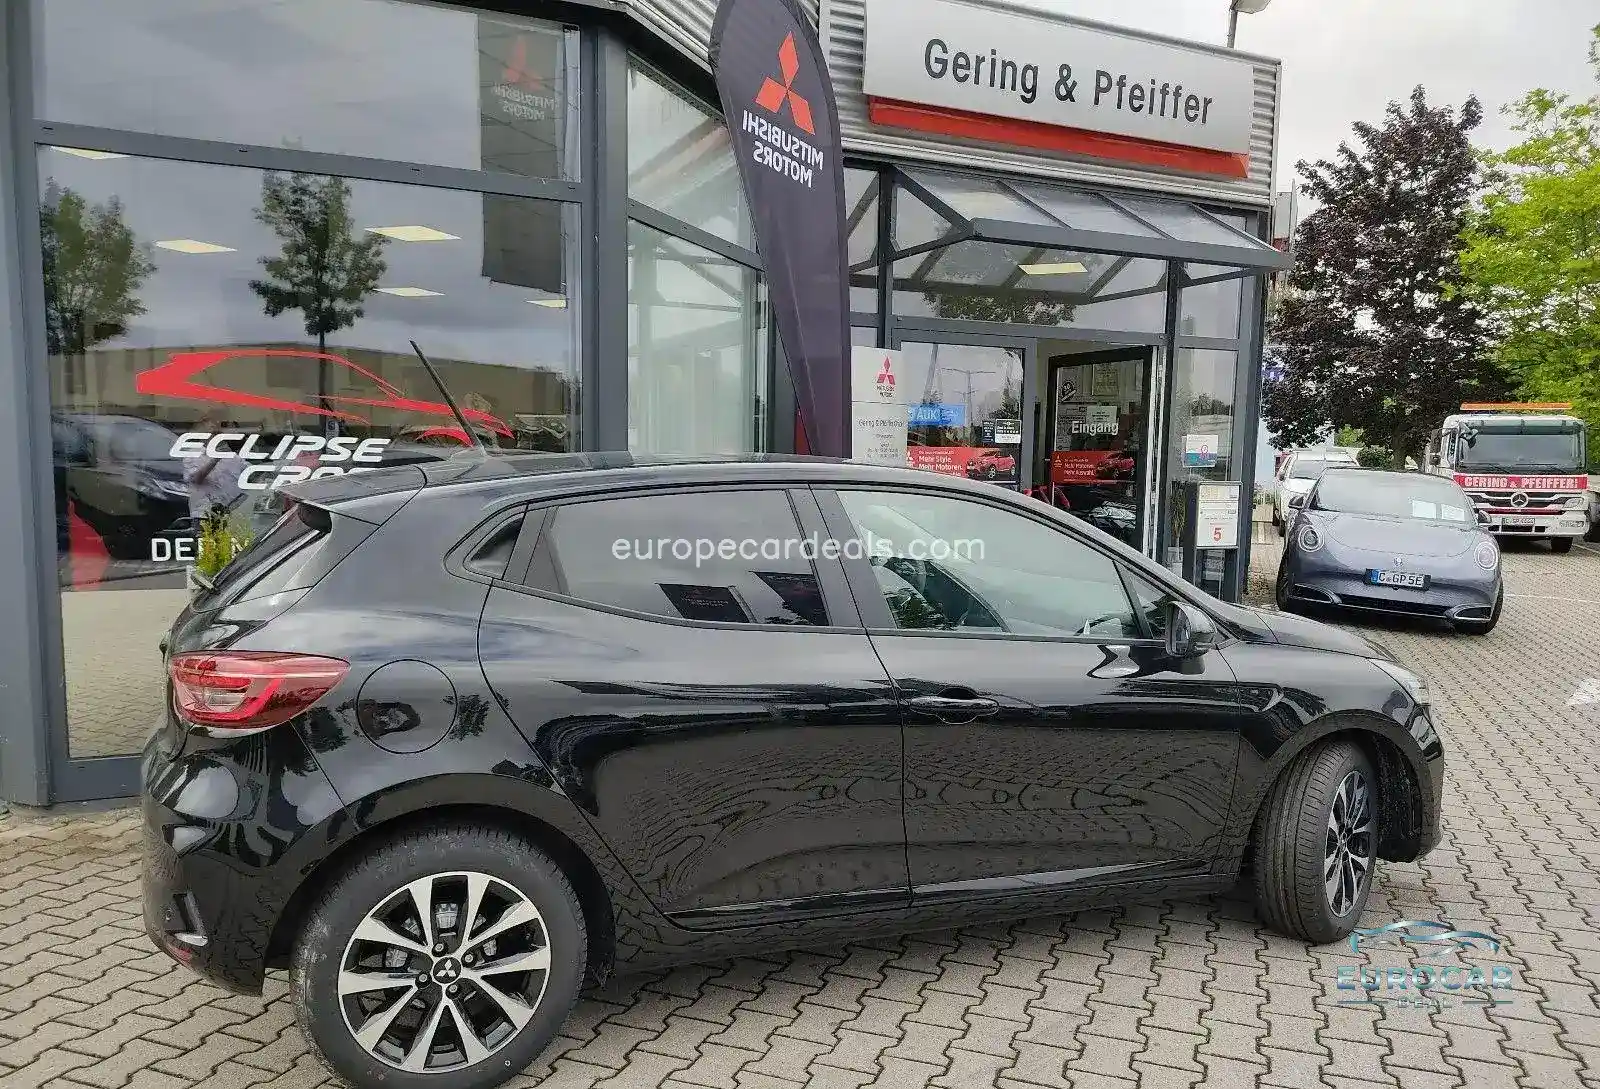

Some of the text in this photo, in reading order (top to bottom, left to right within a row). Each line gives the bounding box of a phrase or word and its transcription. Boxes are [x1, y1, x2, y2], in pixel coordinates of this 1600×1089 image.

[924, 38, 1213, 124] Gering & Pfeiffer
[1072, 421, 1119, 436] Eingang
[169, 432, 391, 463] ECLIPSE
[1464, 476, 1508, 488] GERING
[1214, 527, 1222, 542] 5
[151, 538, 203, 562] DE
[1379, 572, 1386, 582] C
